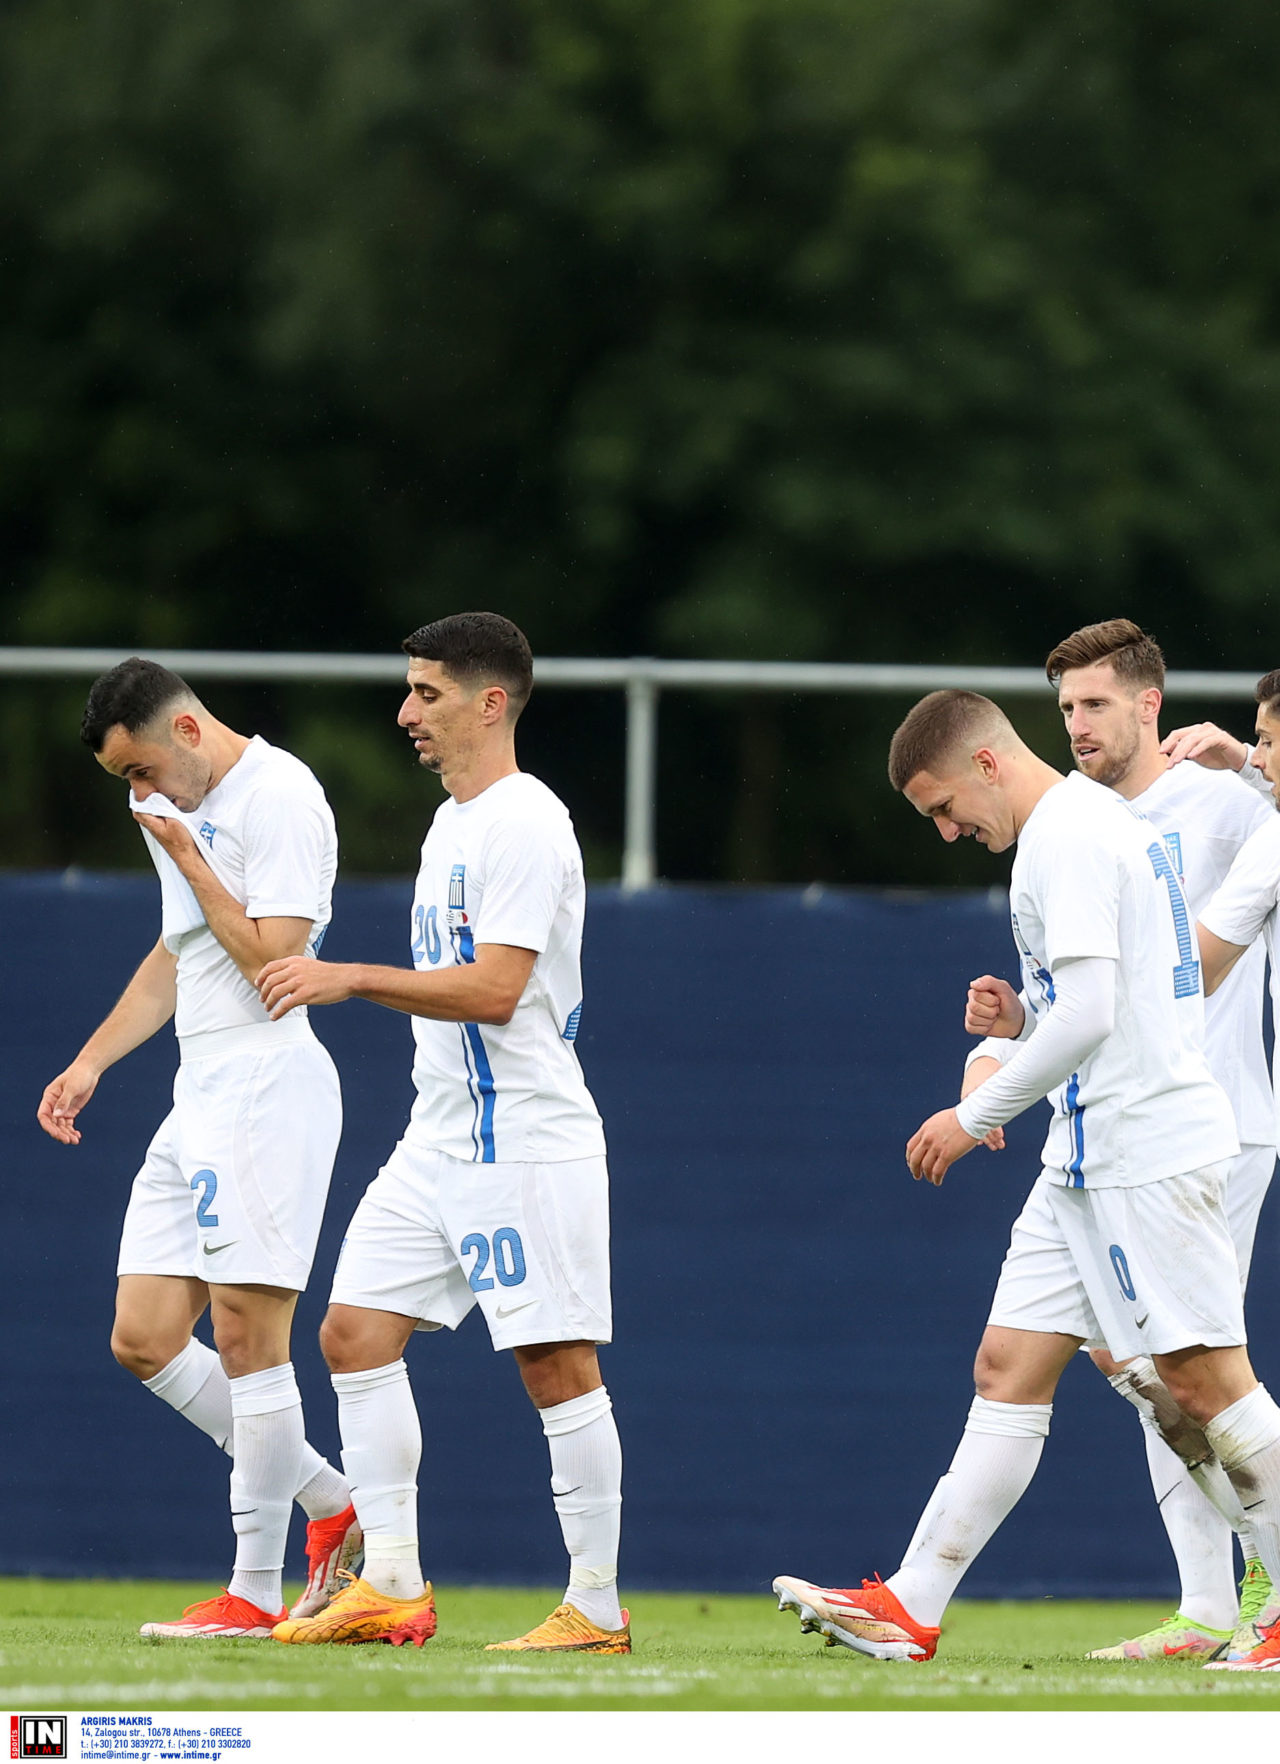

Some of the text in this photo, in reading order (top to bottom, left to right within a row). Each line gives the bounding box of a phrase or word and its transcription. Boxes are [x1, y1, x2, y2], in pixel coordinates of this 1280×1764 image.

[411, 904, 442, 965] 20
[191, 1169, 219, 1227] 2
[461, 1226, 527, 1293] 20
